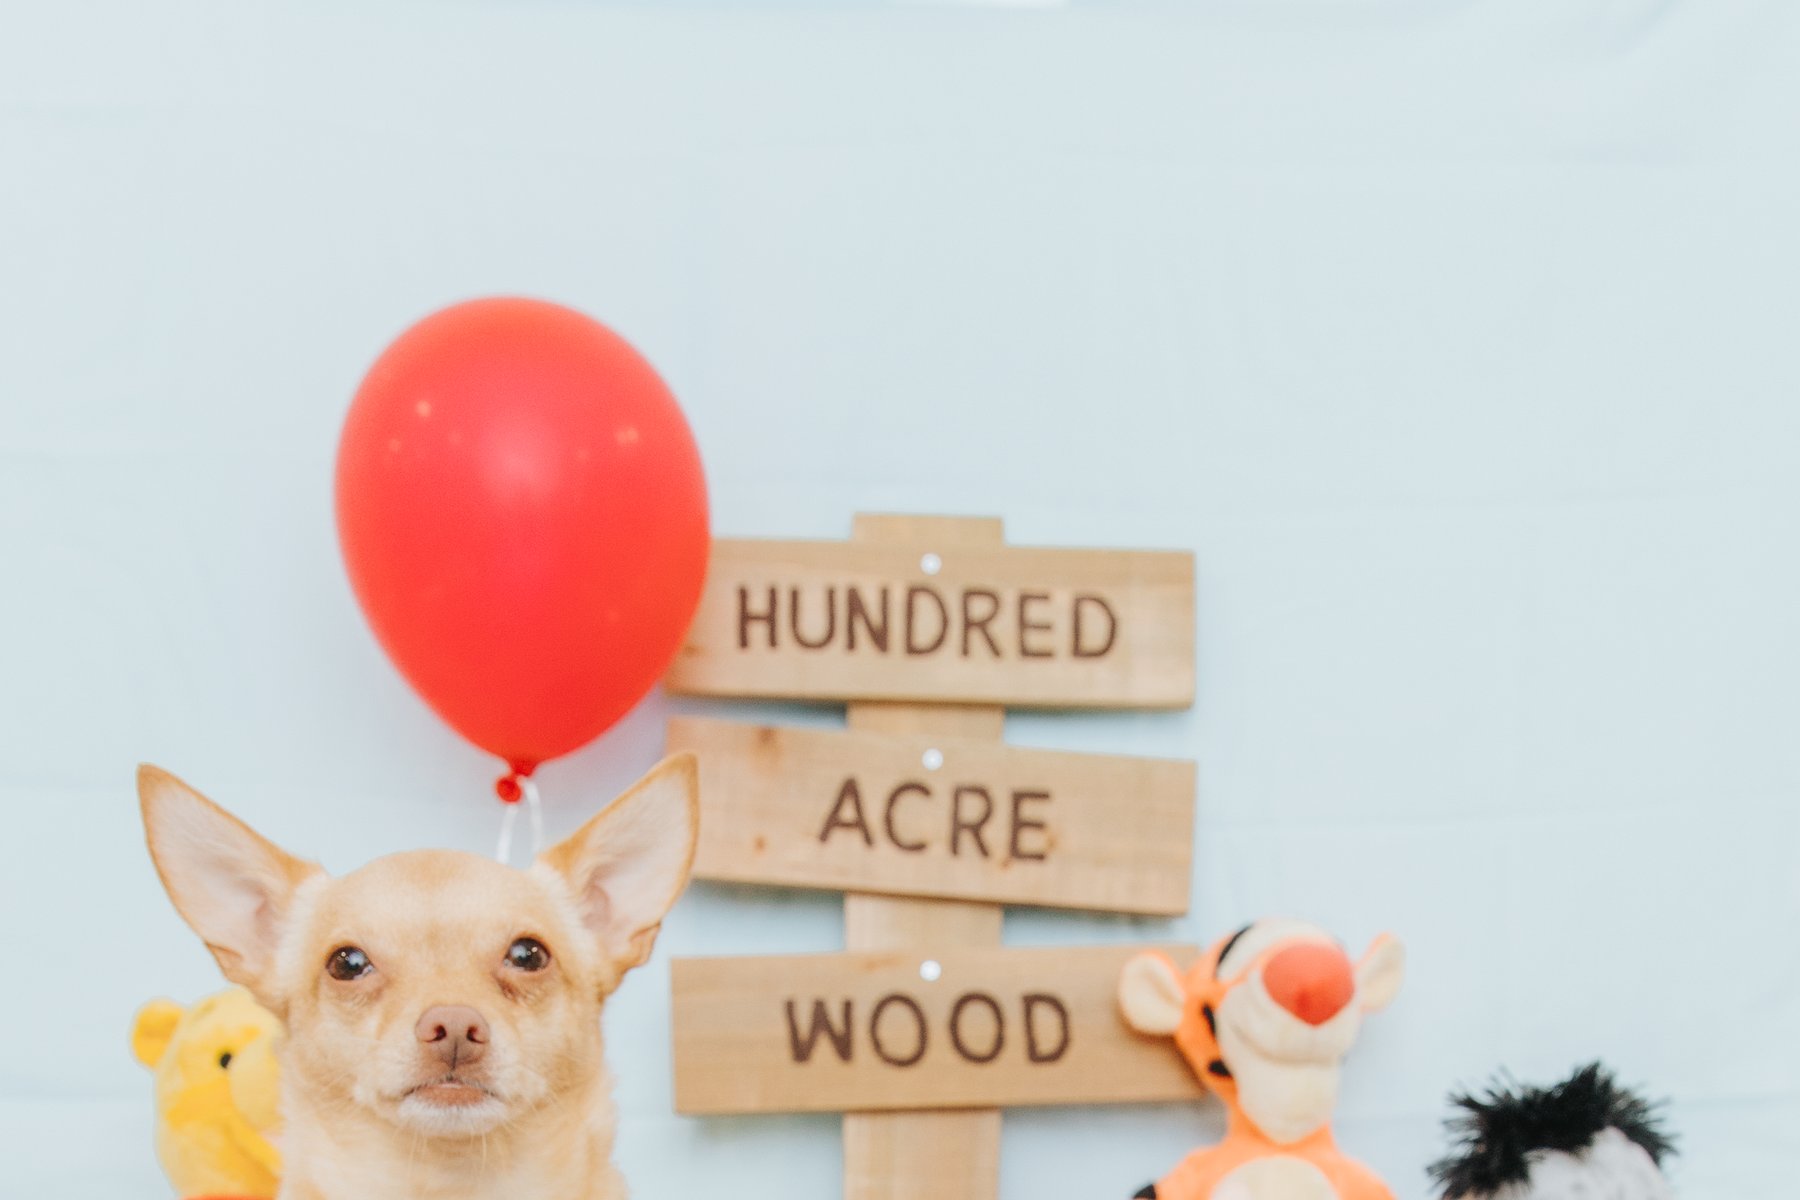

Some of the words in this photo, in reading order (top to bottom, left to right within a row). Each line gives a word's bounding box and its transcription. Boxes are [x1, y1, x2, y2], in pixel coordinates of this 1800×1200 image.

[736, 584, 1118, 660] HUNDRED
[819, 776, 1053, 862] ACRE
[782, 991, 1072, 1068] WOOD
